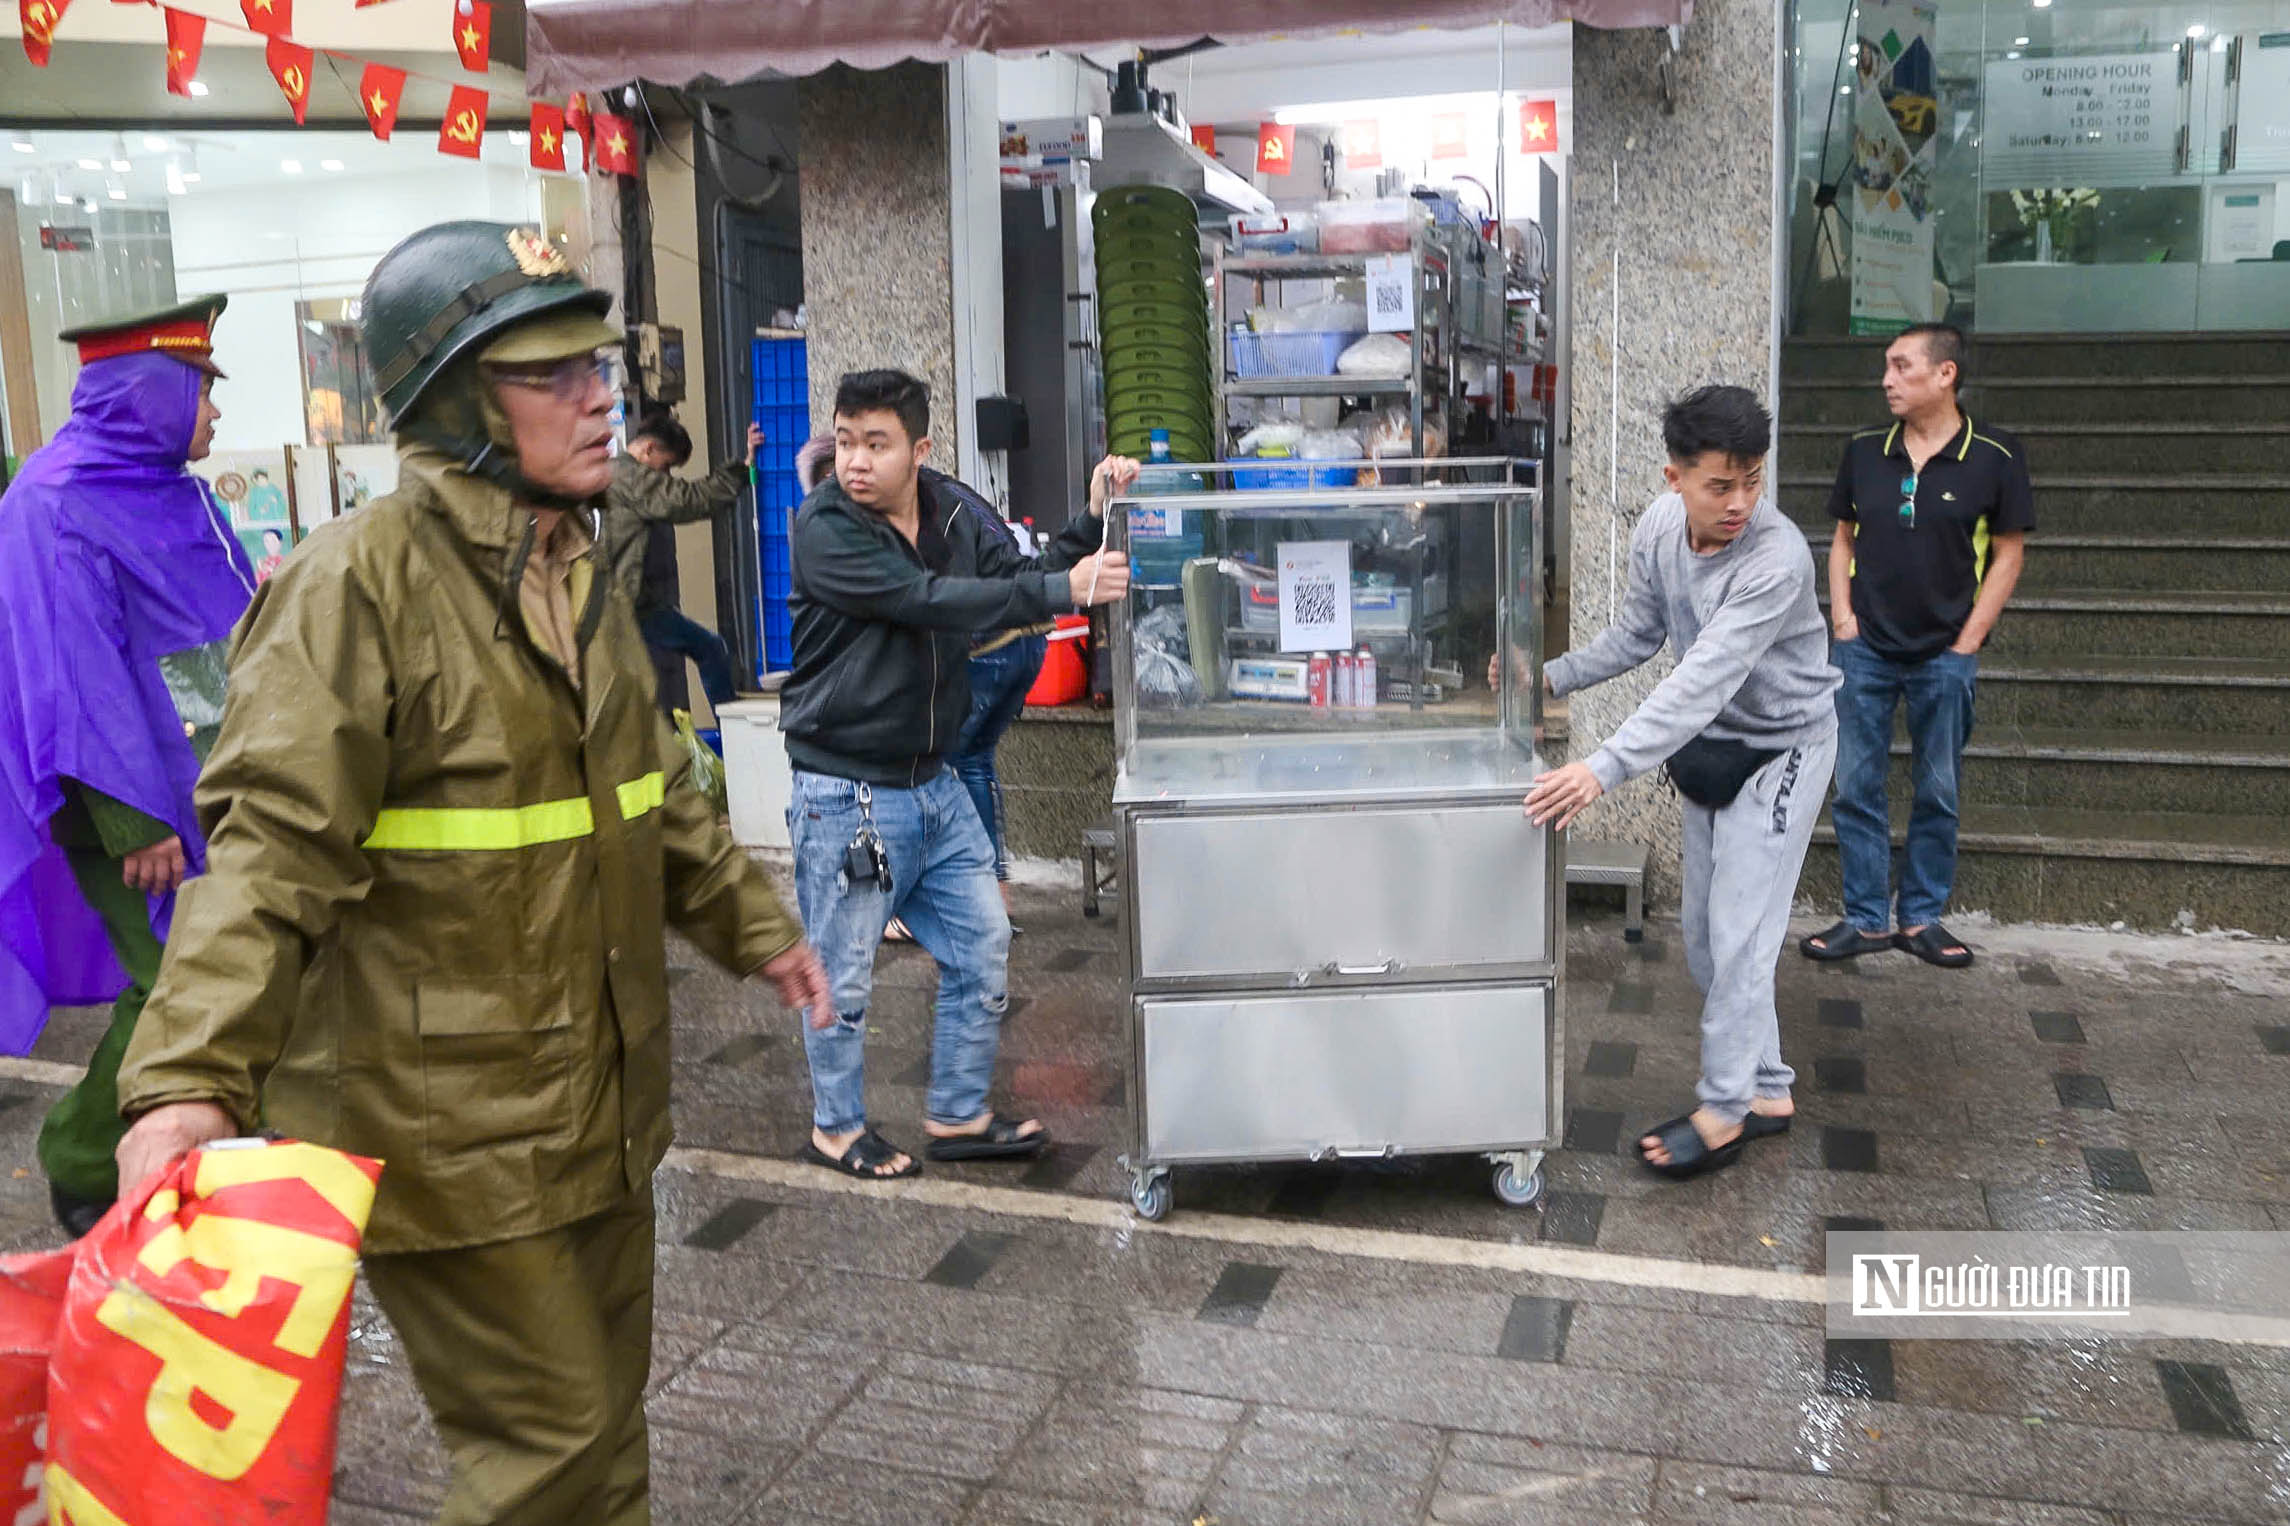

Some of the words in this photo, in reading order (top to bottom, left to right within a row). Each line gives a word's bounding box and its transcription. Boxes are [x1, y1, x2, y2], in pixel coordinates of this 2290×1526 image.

[2022, 66, 2097, 82] OPENING
[2103, 63, 2152, 79] HOUR
[2042, 85, 2094, 97] Monday
[2110, 82, 2151, 95] Friday
